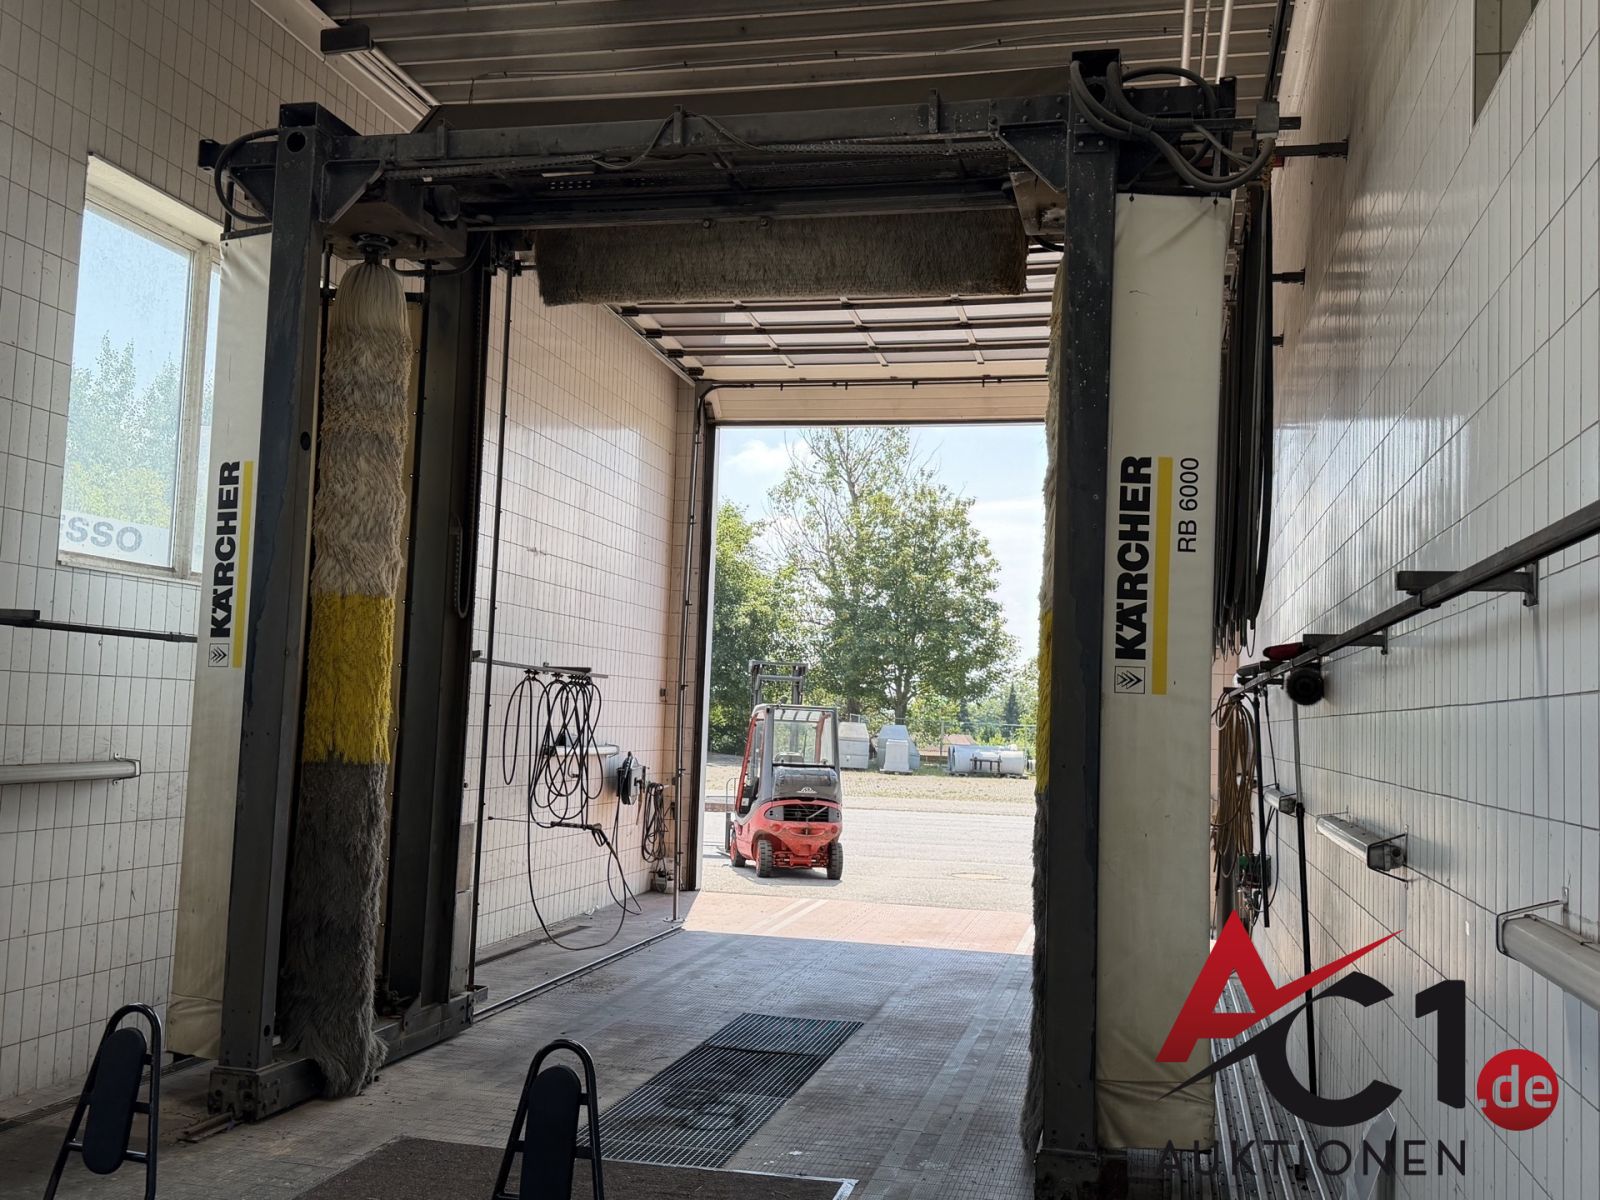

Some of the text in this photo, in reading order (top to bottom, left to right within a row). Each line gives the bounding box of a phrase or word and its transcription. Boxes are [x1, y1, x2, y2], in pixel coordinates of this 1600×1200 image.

[61, 514, 143, 552] SSO
[210, 461, 240, 638] KÄRCHER
[1115, 456, 1152, 660] KÄRCHER
[1177, 457, 1199, 552] RB 6000
